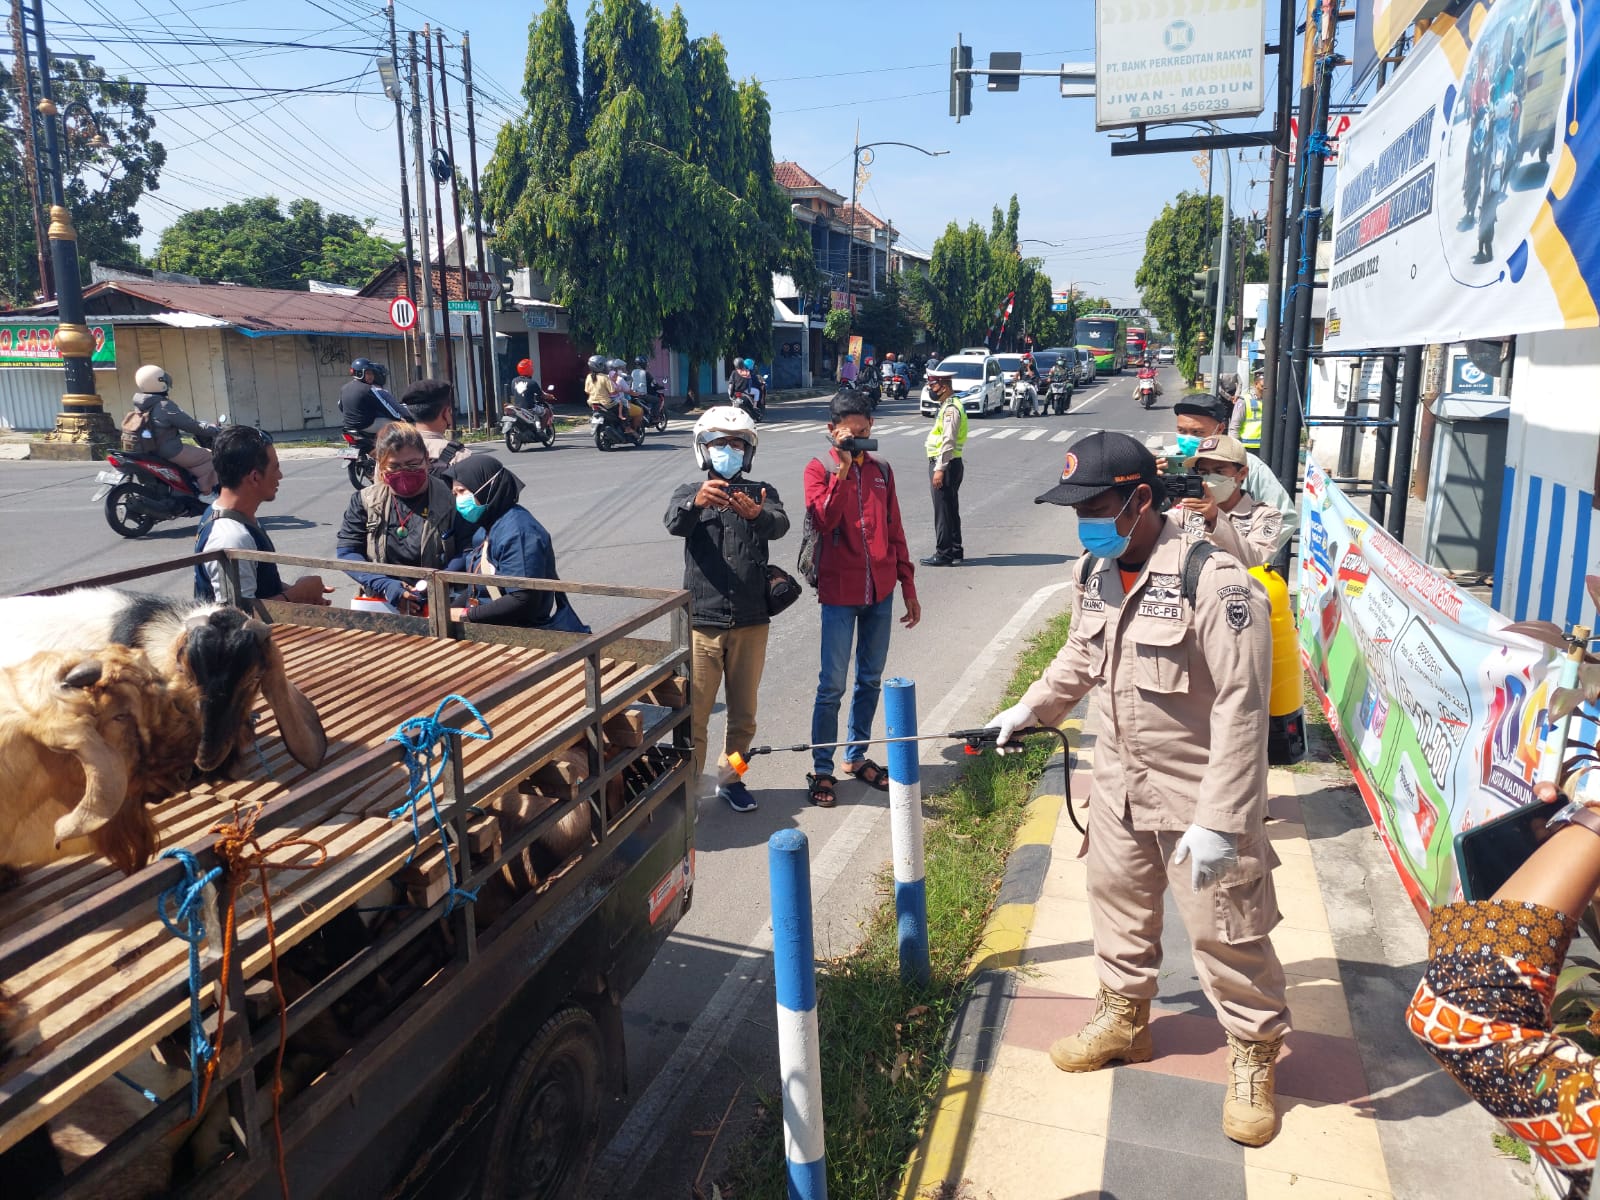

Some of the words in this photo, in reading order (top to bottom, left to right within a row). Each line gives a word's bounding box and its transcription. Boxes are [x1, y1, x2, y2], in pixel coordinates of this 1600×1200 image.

[1106, 62, 1119, 73] PT.
[1121, 59, 1147, 72] BANK
[1149, 53, 1214, 69] PERKREDITAN
[1216, 48, 1254, 62] RAKYAT
[1106, 70, 1183, 91] POLATAMA
[1187, 63, 1254, 82] KUSUMA
[1107, 90, 1164, 105] JIWAN
[1181, 81, 1254, 98] MADIUN
[1146, 103, 1177, 116] 0351
[1181, 98, 1230, 113] 456239
[1142, 605, 1178, 618] TRC-PB
[1490, 769, 1505, 789] KOTA
[1503, 777, 1533, 804] MADIUN
